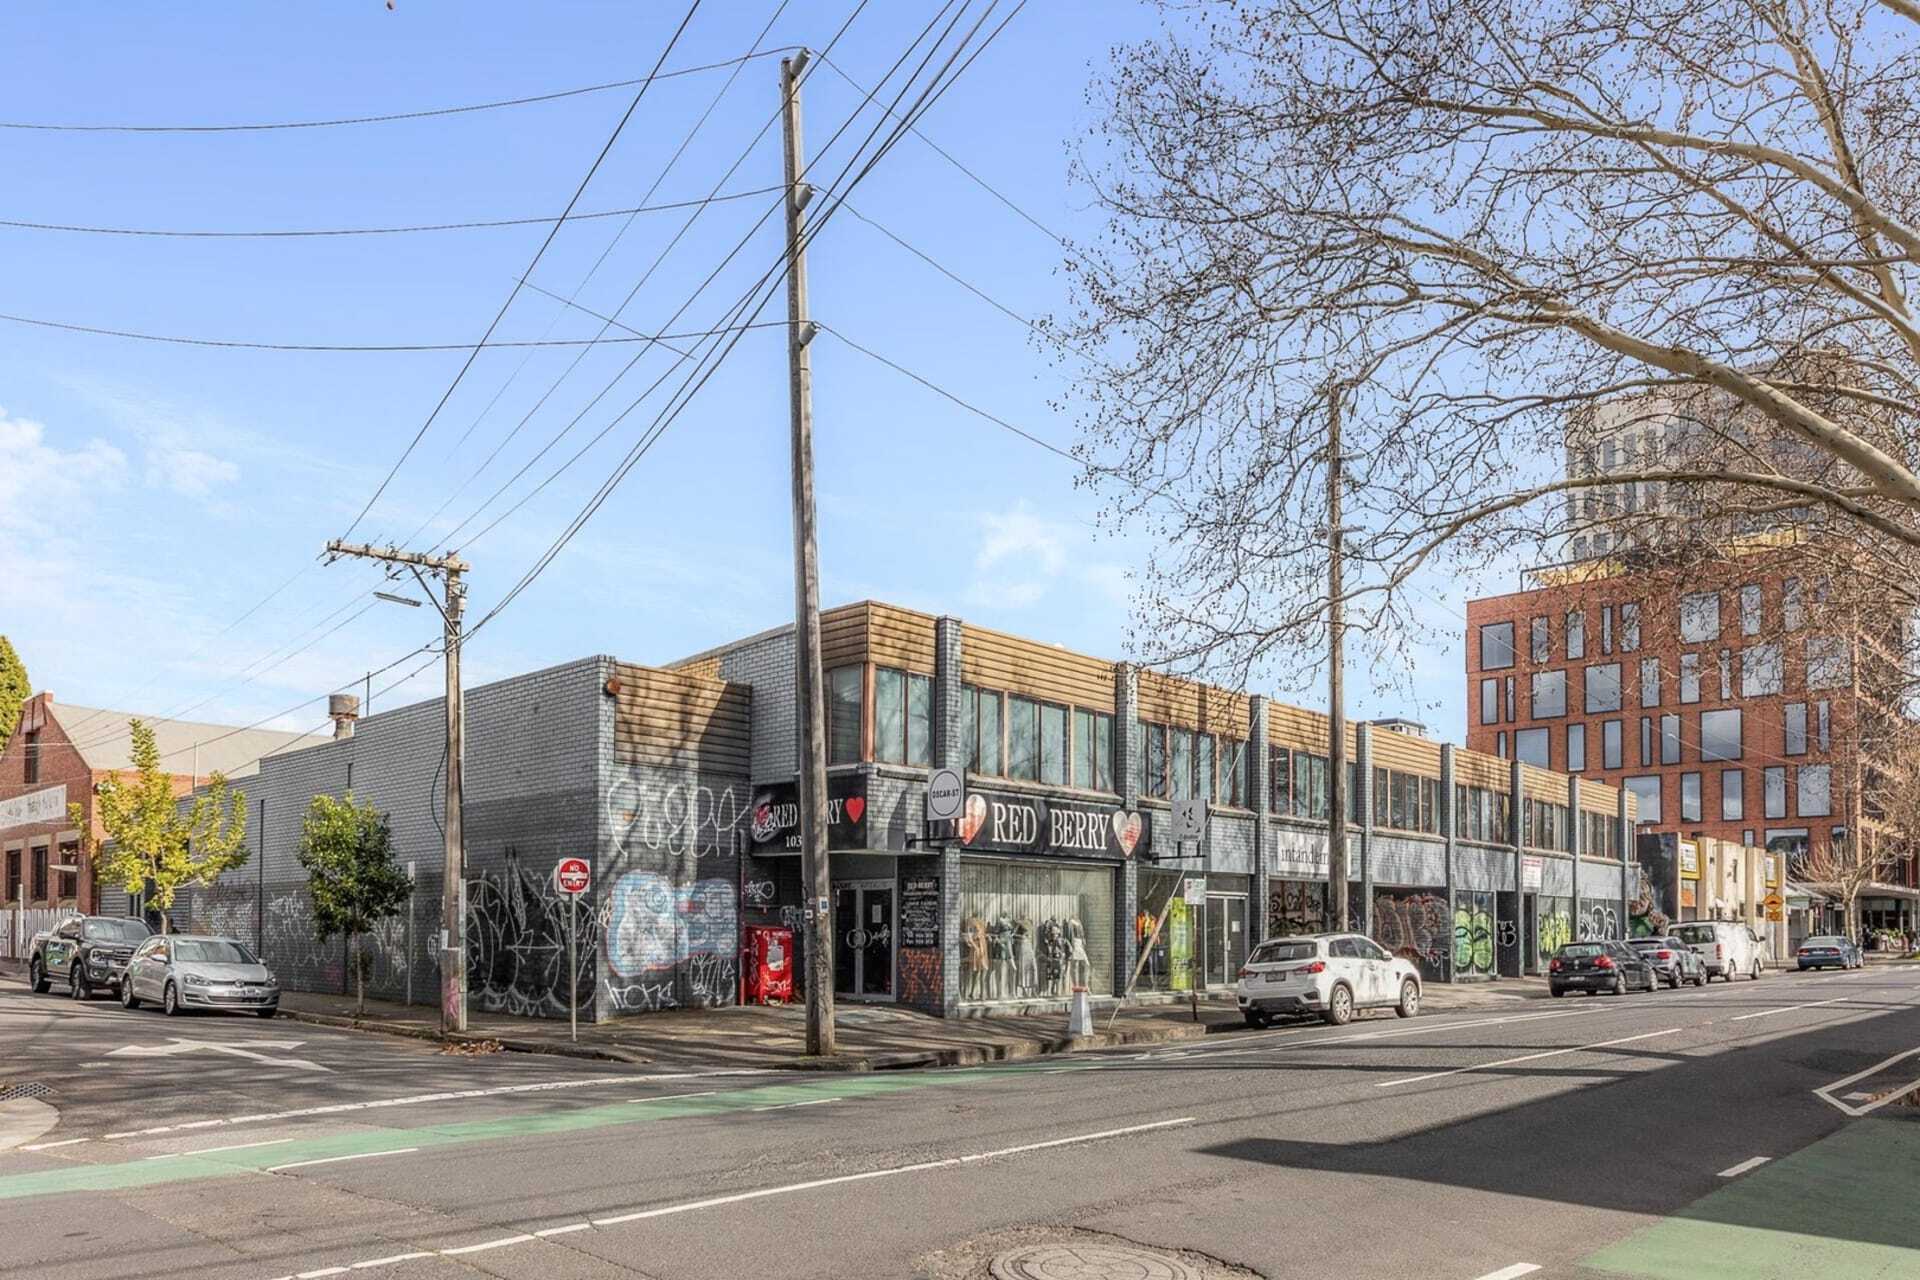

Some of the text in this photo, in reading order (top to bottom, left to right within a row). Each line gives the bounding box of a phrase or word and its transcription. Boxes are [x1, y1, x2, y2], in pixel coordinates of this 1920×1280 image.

[773, 803, 798, 829] RED
[991, 802, 1111, 850] RED BERRY
[569, 863, 580, 871] NO
[563, 879, 585, 888] ENTRY
